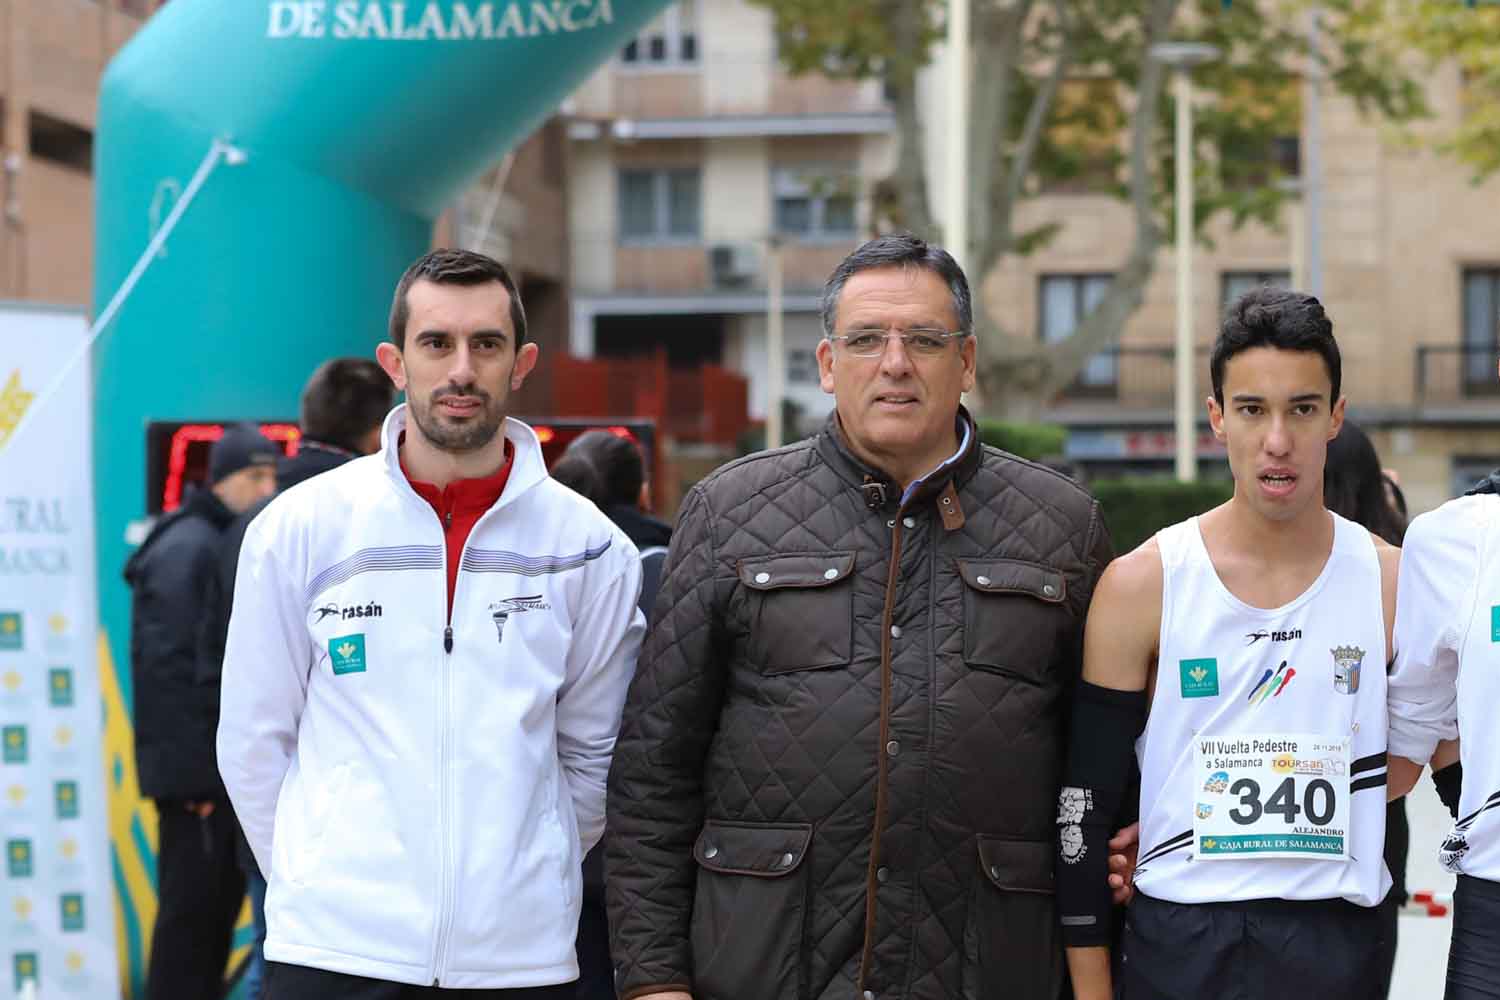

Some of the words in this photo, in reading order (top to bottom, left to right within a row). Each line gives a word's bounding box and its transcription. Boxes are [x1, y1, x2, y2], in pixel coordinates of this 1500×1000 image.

[266, 0, 324, 38] DE
[333, 0, 615, 40] SALAMANCA
[342, 600, 383, 620] rasán
[1200, 741, 1215, 755] VII
[1217, 740, 1250, 754] Vuelta
[1252, 739, 1298, 753] Pedestre
[1205, 760, 1212, 769] a
[1214, 757, 1263, 769] Salamanca
[1228, 777, 1336, 826] 340
[1292, 826, 1344, 836] ALEJANDRO
[1219, 841, 1242, 850] CAJA
[1243, 840, 1273, 849] RURAL
[1275, 840, 1288, 848] DE
[1289, 840, 1343, 851] SALAMANCA
